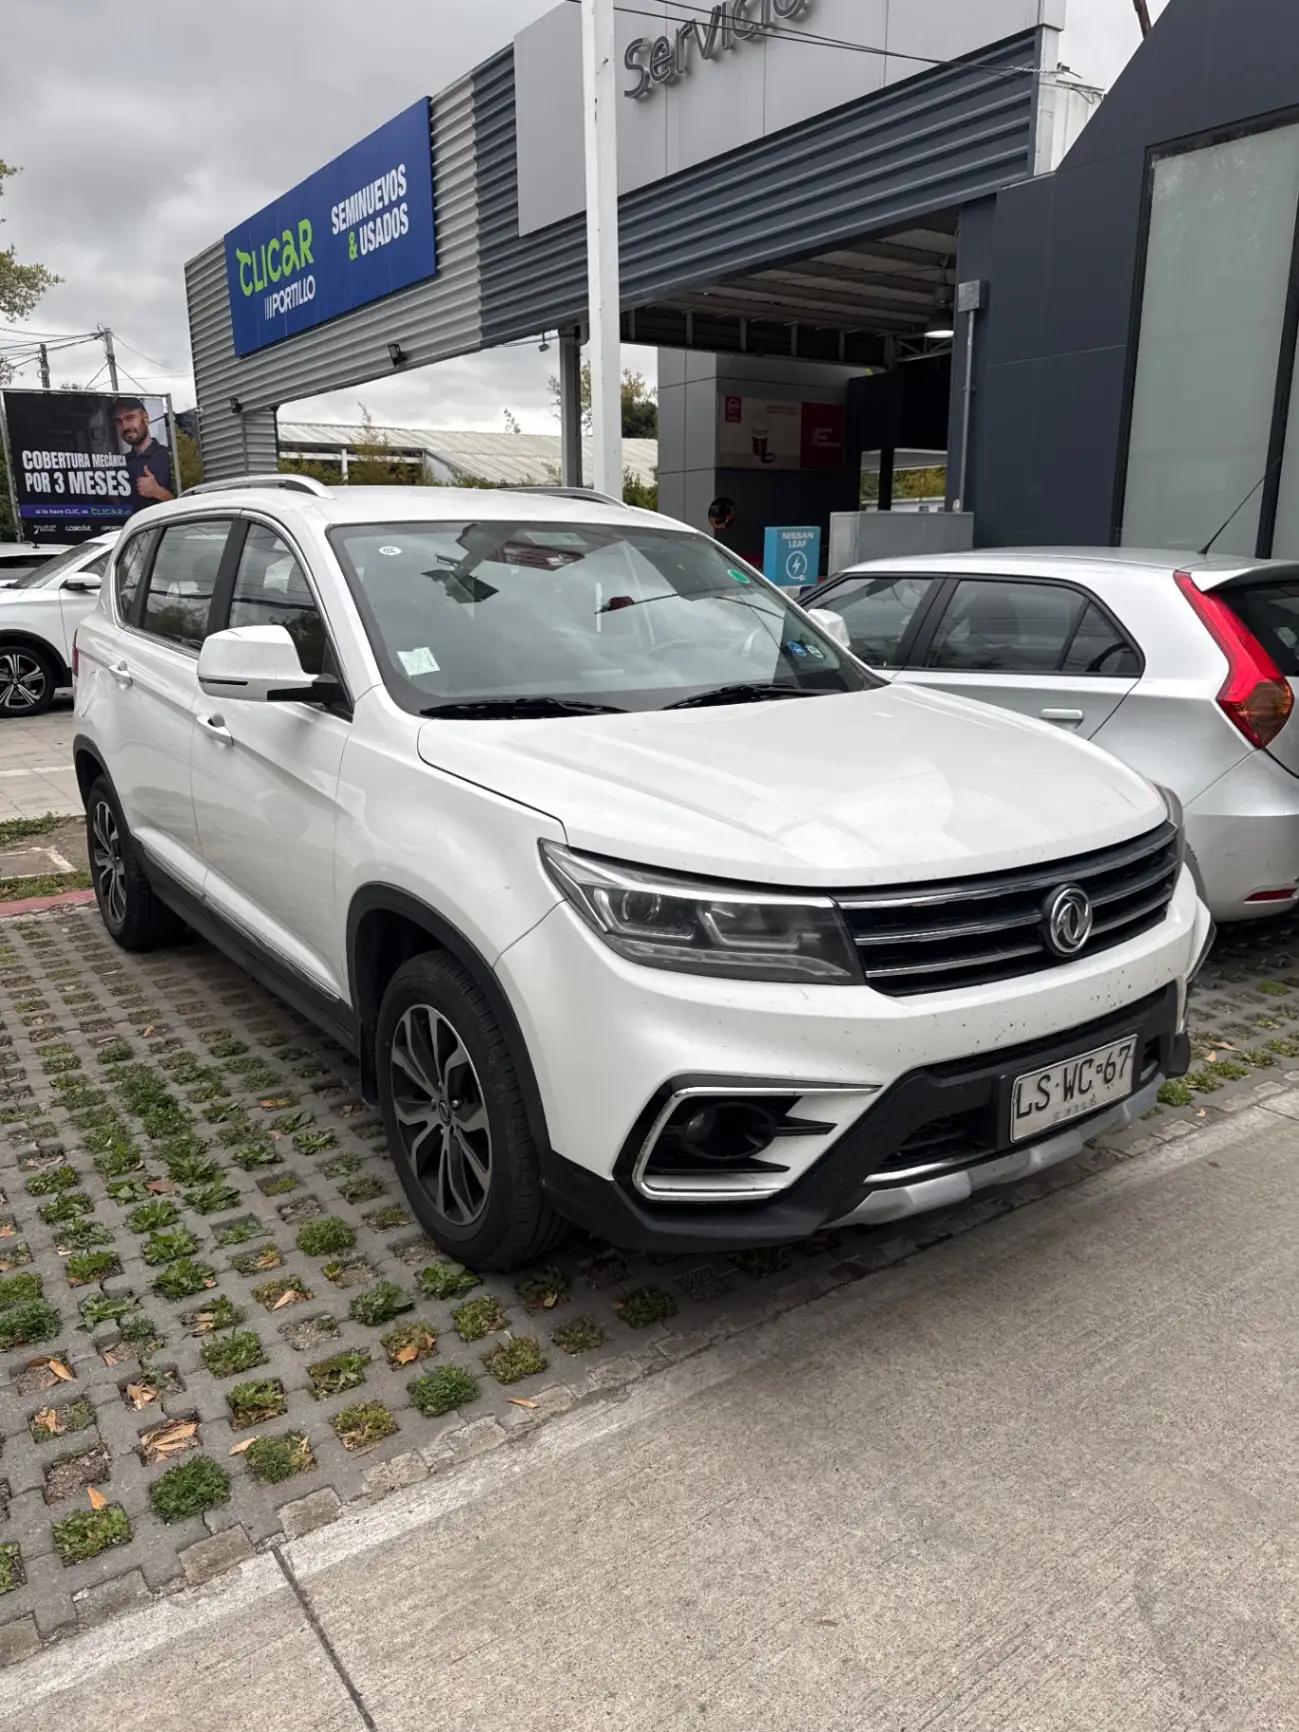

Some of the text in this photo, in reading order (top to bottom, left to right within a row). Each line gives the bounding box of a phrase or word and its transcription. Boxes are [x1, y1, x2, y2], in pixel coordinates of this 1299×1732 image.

[331, 163, 408, 236] SEMINUEVOS
[349, 202, 409, 260] & USADOS
[22, 450, 91, 470] COBERTURA
[25, 470, 132, 497] POR 3 MESES
[782, 532, 814, 540] NISSAN
[788, 540, 808, 548] LEAF
